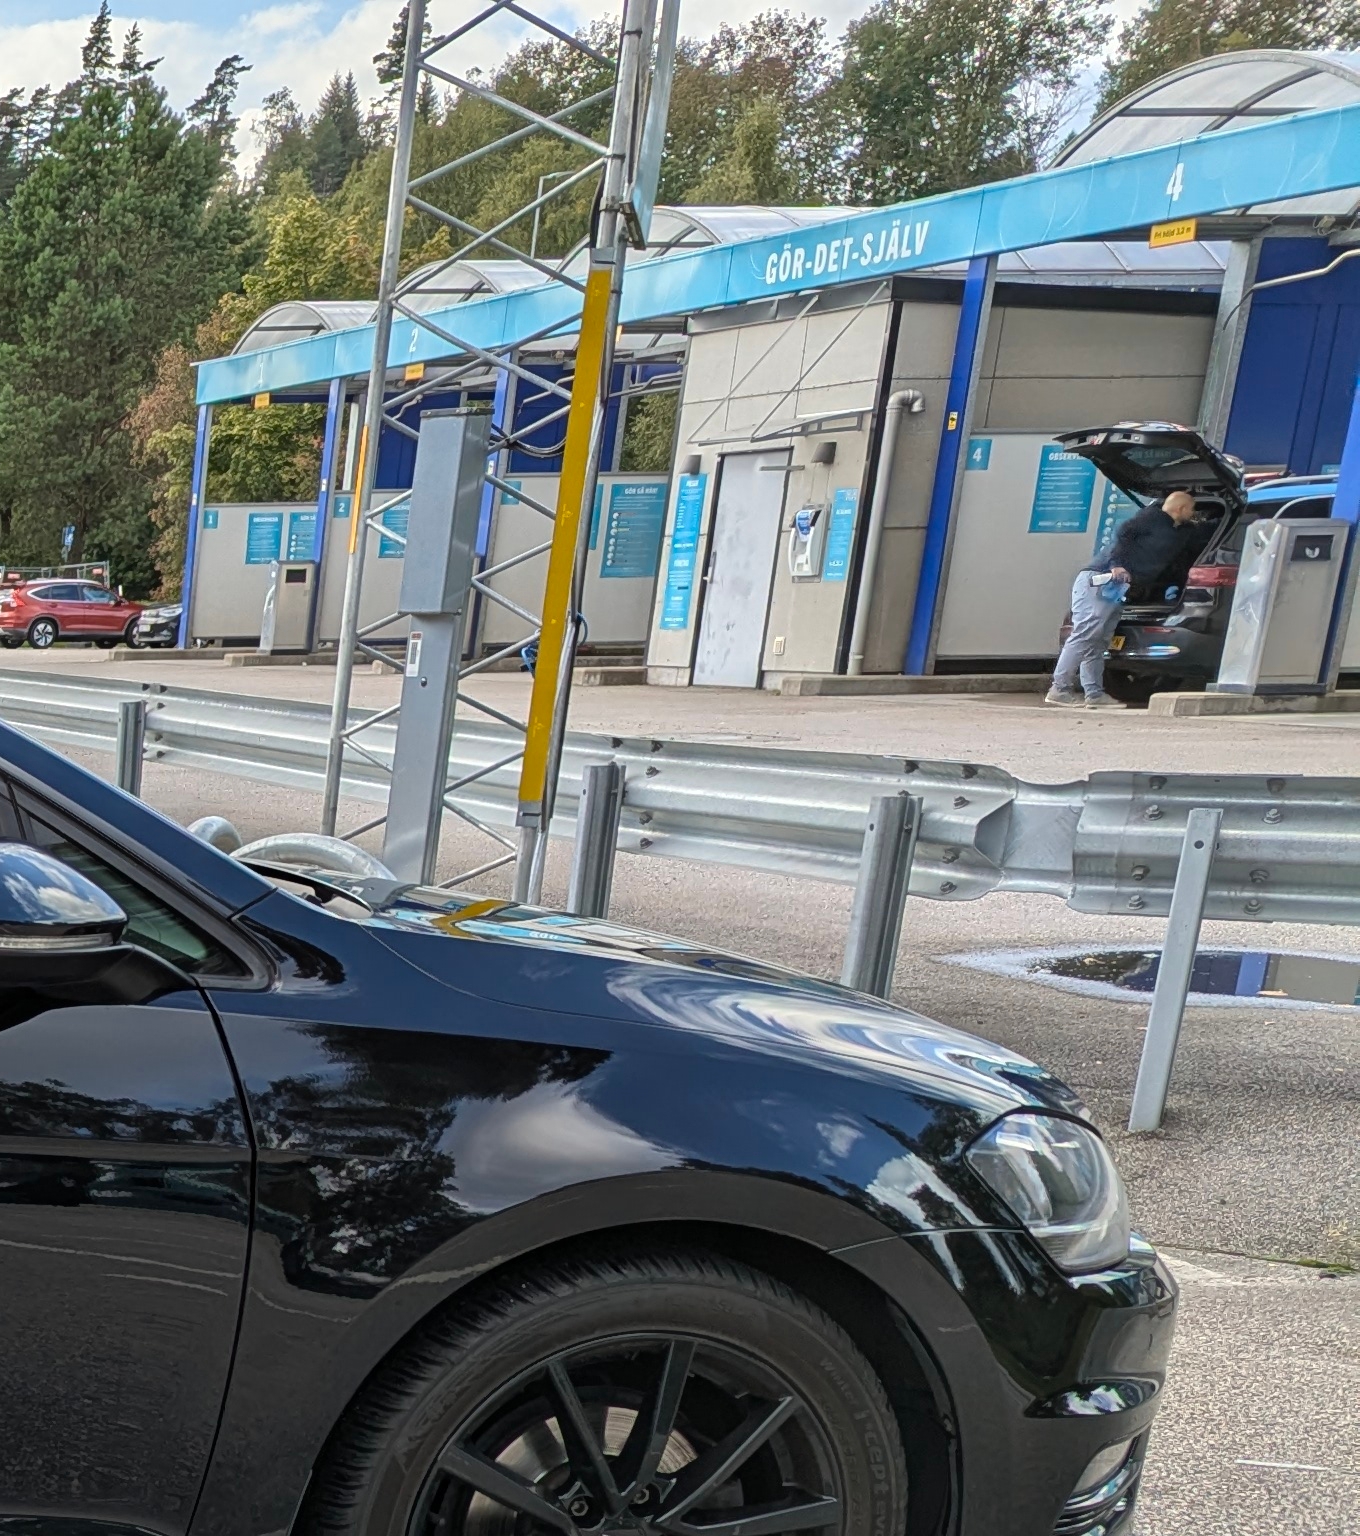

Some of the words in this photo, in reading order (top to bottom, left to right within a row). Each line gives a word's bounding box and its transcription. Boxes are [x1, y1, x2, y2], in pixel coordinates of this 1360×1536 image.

[1166, 162, 1184, 201] 4
[765, 219, 930, 285] GÖR-DET-SJÄLV
[409, 327, 419, 353] 2
[972, 447, 982, 462] 4
[338, 502, 345, 513] 2
[208, 514, 213, 524] 1
